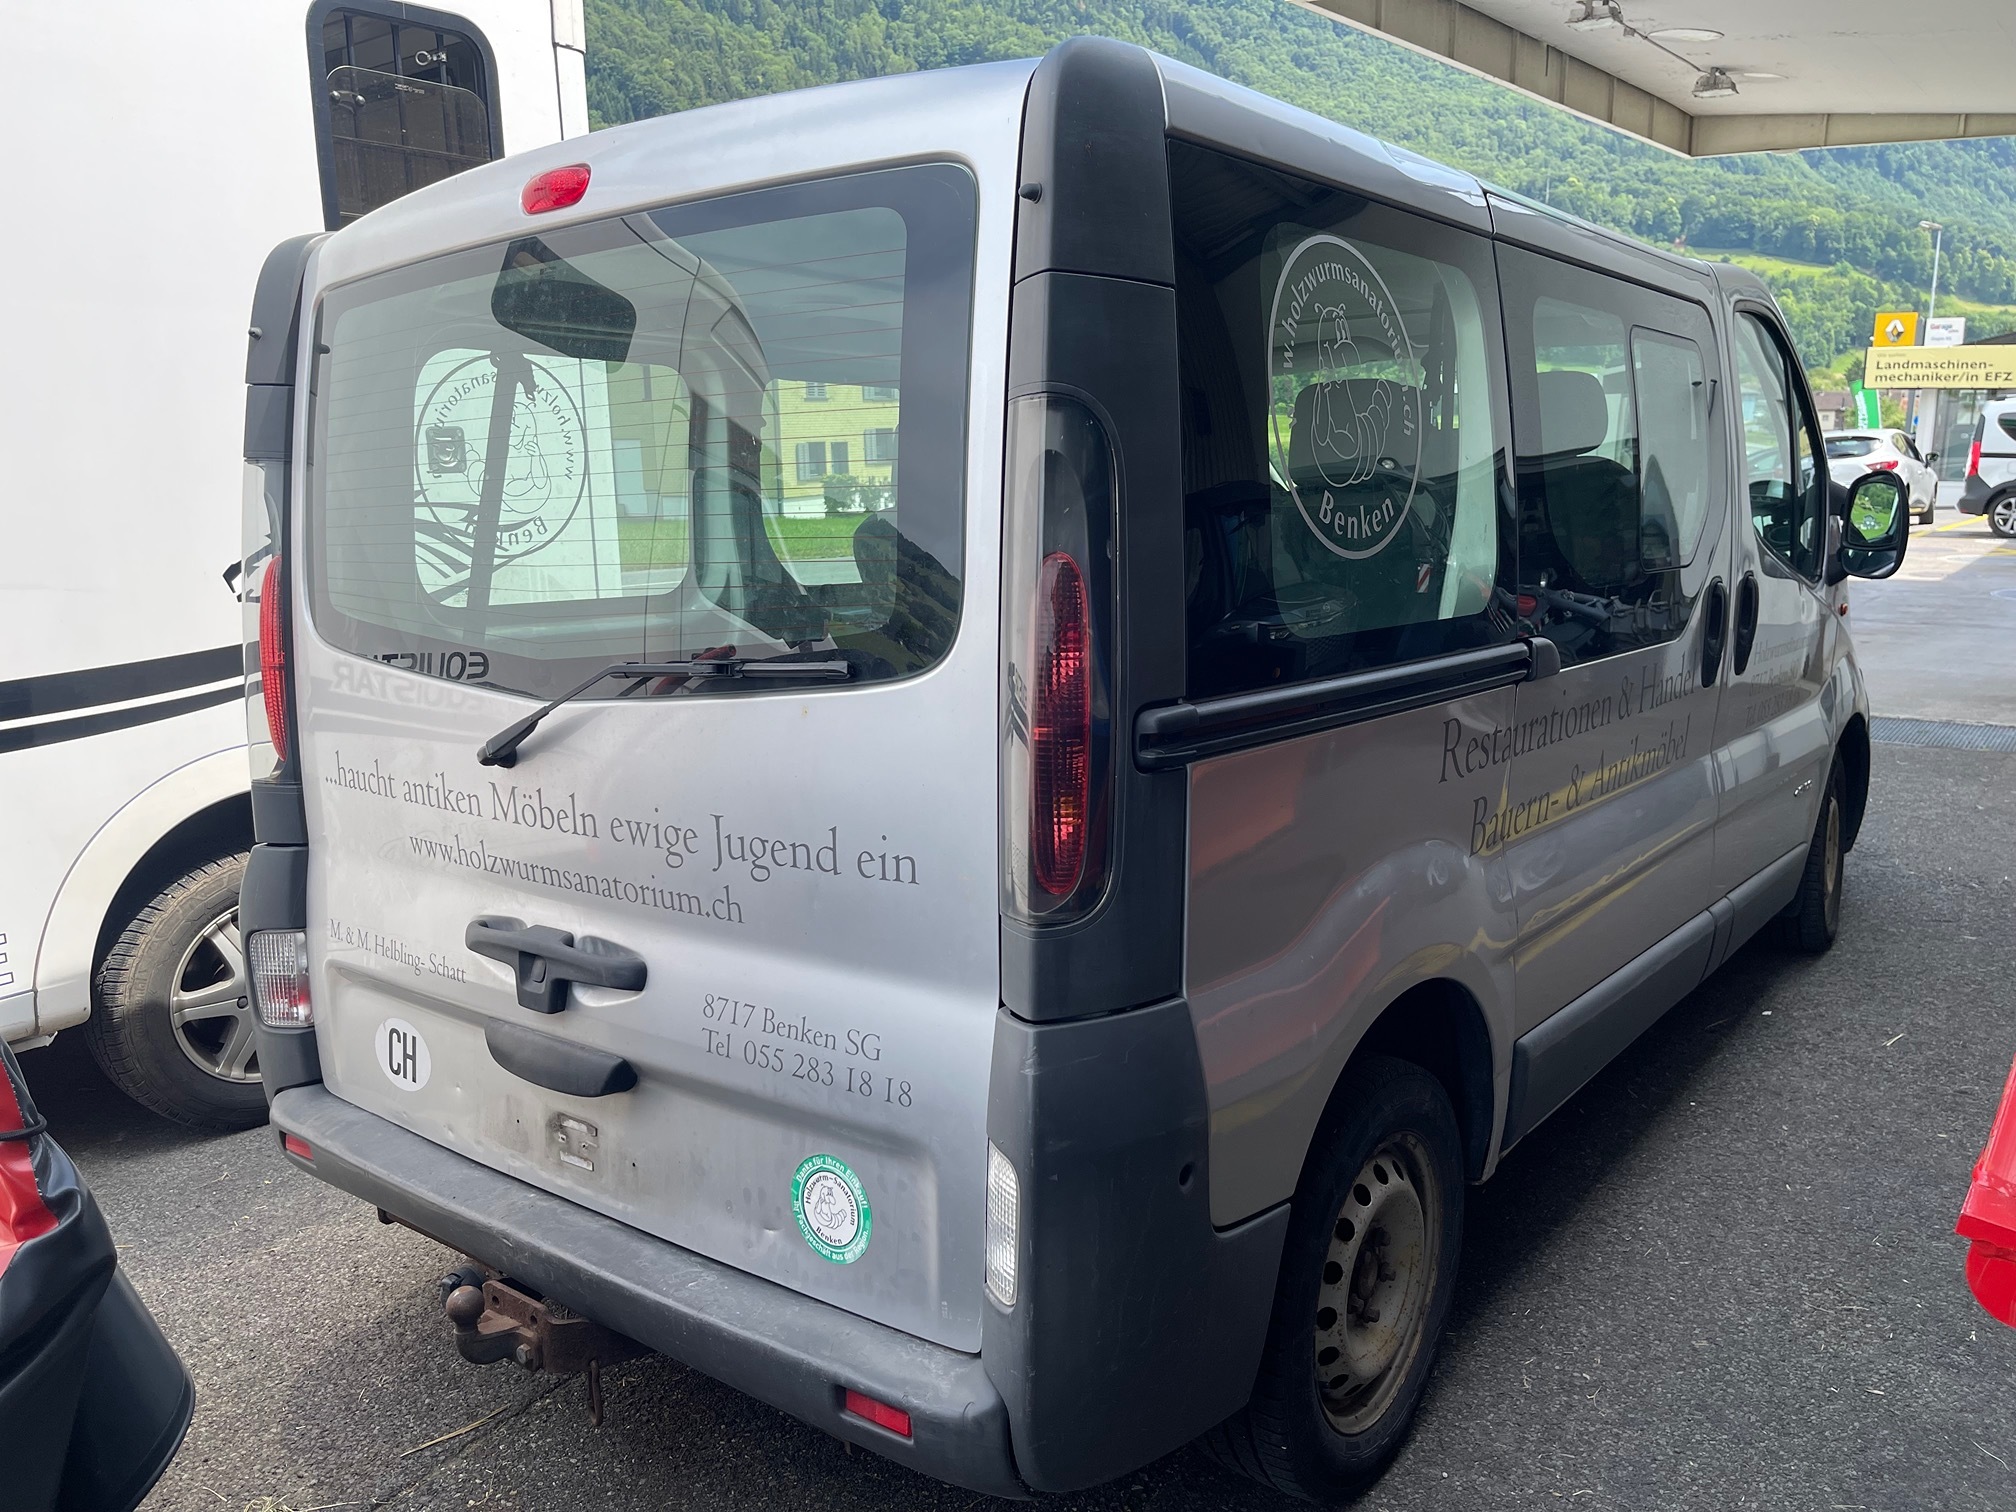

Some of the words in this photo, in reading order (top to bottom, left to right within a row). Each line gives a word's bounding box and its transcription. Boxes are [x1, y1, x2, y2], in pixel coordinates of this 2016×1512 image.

[1874, 371, 1979, 383] mechaniker/in
[1984, 371, 2013, 382] EFZ
[1876, 359, 1994, 370] Landmaschinen-
[1318, 489, 1395, 540] Benken
[1438, 689, 1612, 785] Restaurationen
[1618, 674, 1635, 721] &
[1638, 648, 1698, 714] Handel
[1469, 791, 1560, 858] Bauern-
[1566, 763, 1585, 811] &
[1589, 711, 1691, 801] Antikmöbel
[402, 772, 482, 818] antiken
[491, 782, 600, 839] Möbeln
[610, 807, 699, 868] ewige
[710, 813, 842, 882] Jugend
[856, 834, 920, 885] ein
[409, 831, 745, 924] www.holzwurmsanatorium.ch
[330, 918, 344, 942] M.
[345, 926, 354, 946] &
[357, 928, 372, 952] M.
[374, 934, 426, 977] Helbling-
[428, 952, 467, 984] Schatt
[388, 1027, 417, 1084] CH
[702, 993, 756, 1029] 8717
[761, 1007, 837, 1051] Benken
[844, 1028, 882, 1061] SG
[701, 1027, 732, 1059] Tel
[743, 1040, 785, 1073] 055
[792, 1053, 834, 1087] 283
[846, 1066, 873, 1097] 18
[884, 1076, 913, 1108] 18
[796, 1161, 813, 1182] Danke
[812, 1156, 824, 1166] für
[825, 1157, 845, 1173] Ihren
[845, 1171, 868, 1208] Einkauf!
[816, 1227, 842, 1244] Benken
[831, 1252, 844, 1261] aus
[844, 1250, 854, 1260] der
